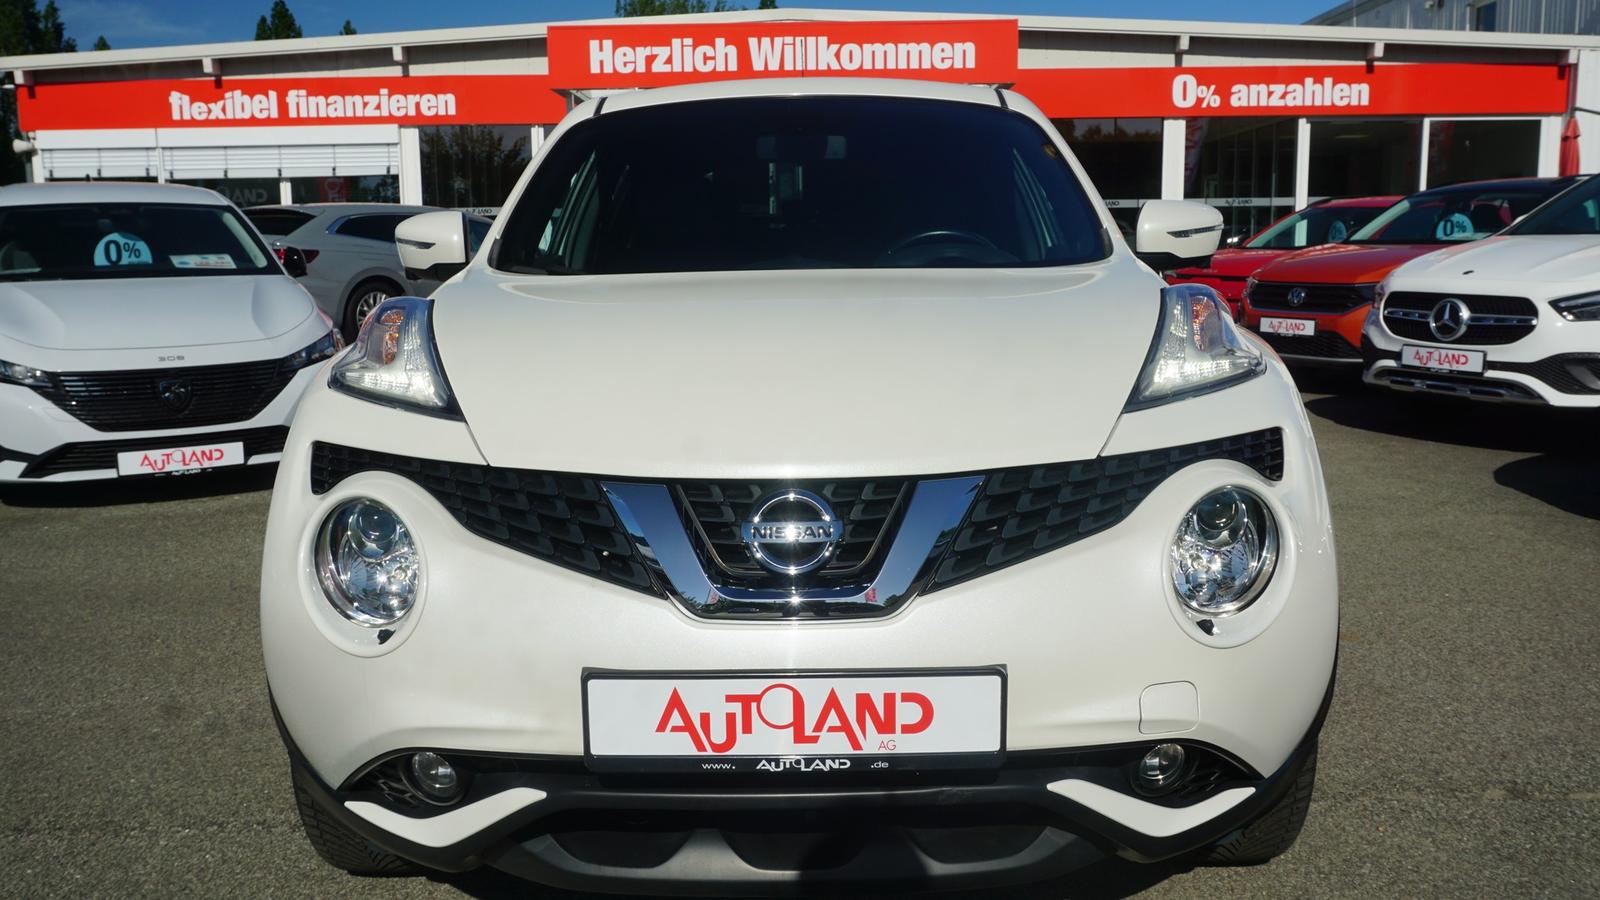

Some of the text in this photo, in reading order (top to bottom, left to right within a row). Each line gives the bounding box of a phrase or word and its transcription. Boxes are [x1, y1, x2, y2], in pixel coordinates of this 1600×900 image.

[589, 36, 976, 73] Herzlich Willkommen
[1172, 74, 1370, 108] 0% anzahlen
[168, 89, 456, 120] flexibel finanzieren
[1442, 218, 1467, 237] 0%
[104, 239, 141, 265] 0%
[140, 448, 225, 472] AUTOLAND
[751, 526, 832, 539] NISSAN
[655, 683, 935, 753] AUTOLAND
[878, 739, 897, 752] AG
[756, 757, 851, 772] AUTOLAND
